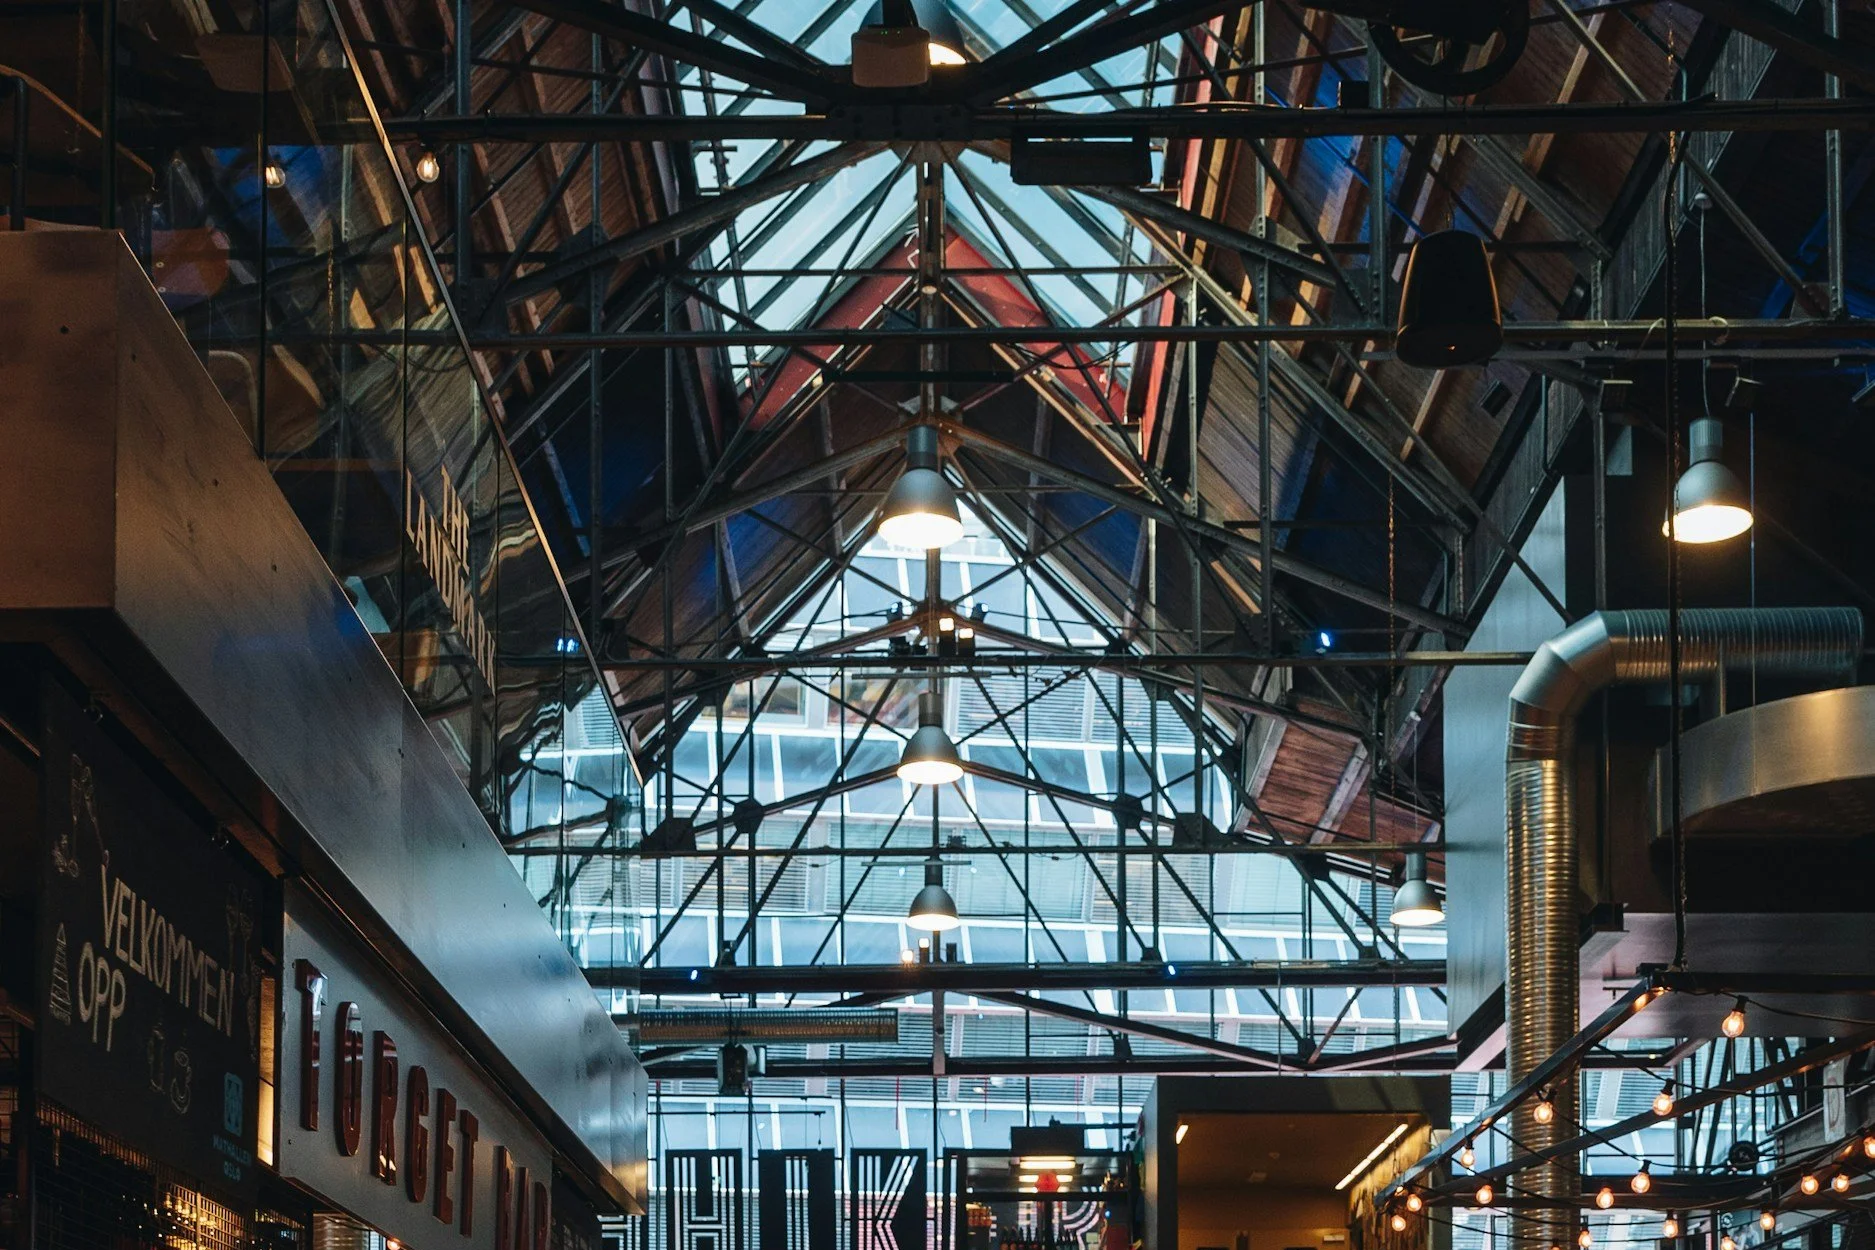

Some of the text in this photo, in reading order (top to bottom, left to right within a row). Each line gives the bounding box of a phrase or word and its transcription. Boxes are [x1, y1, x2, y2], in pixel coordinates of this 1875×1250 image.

[404, 467, 497, 697] LANDMARK
[441, 464, 470, 577] THE
[78, 941, 127, 1052] OPP
[101, 863, 234, 1038] VELKOMMEN
[296, 959, 480, 1238] TORGET
